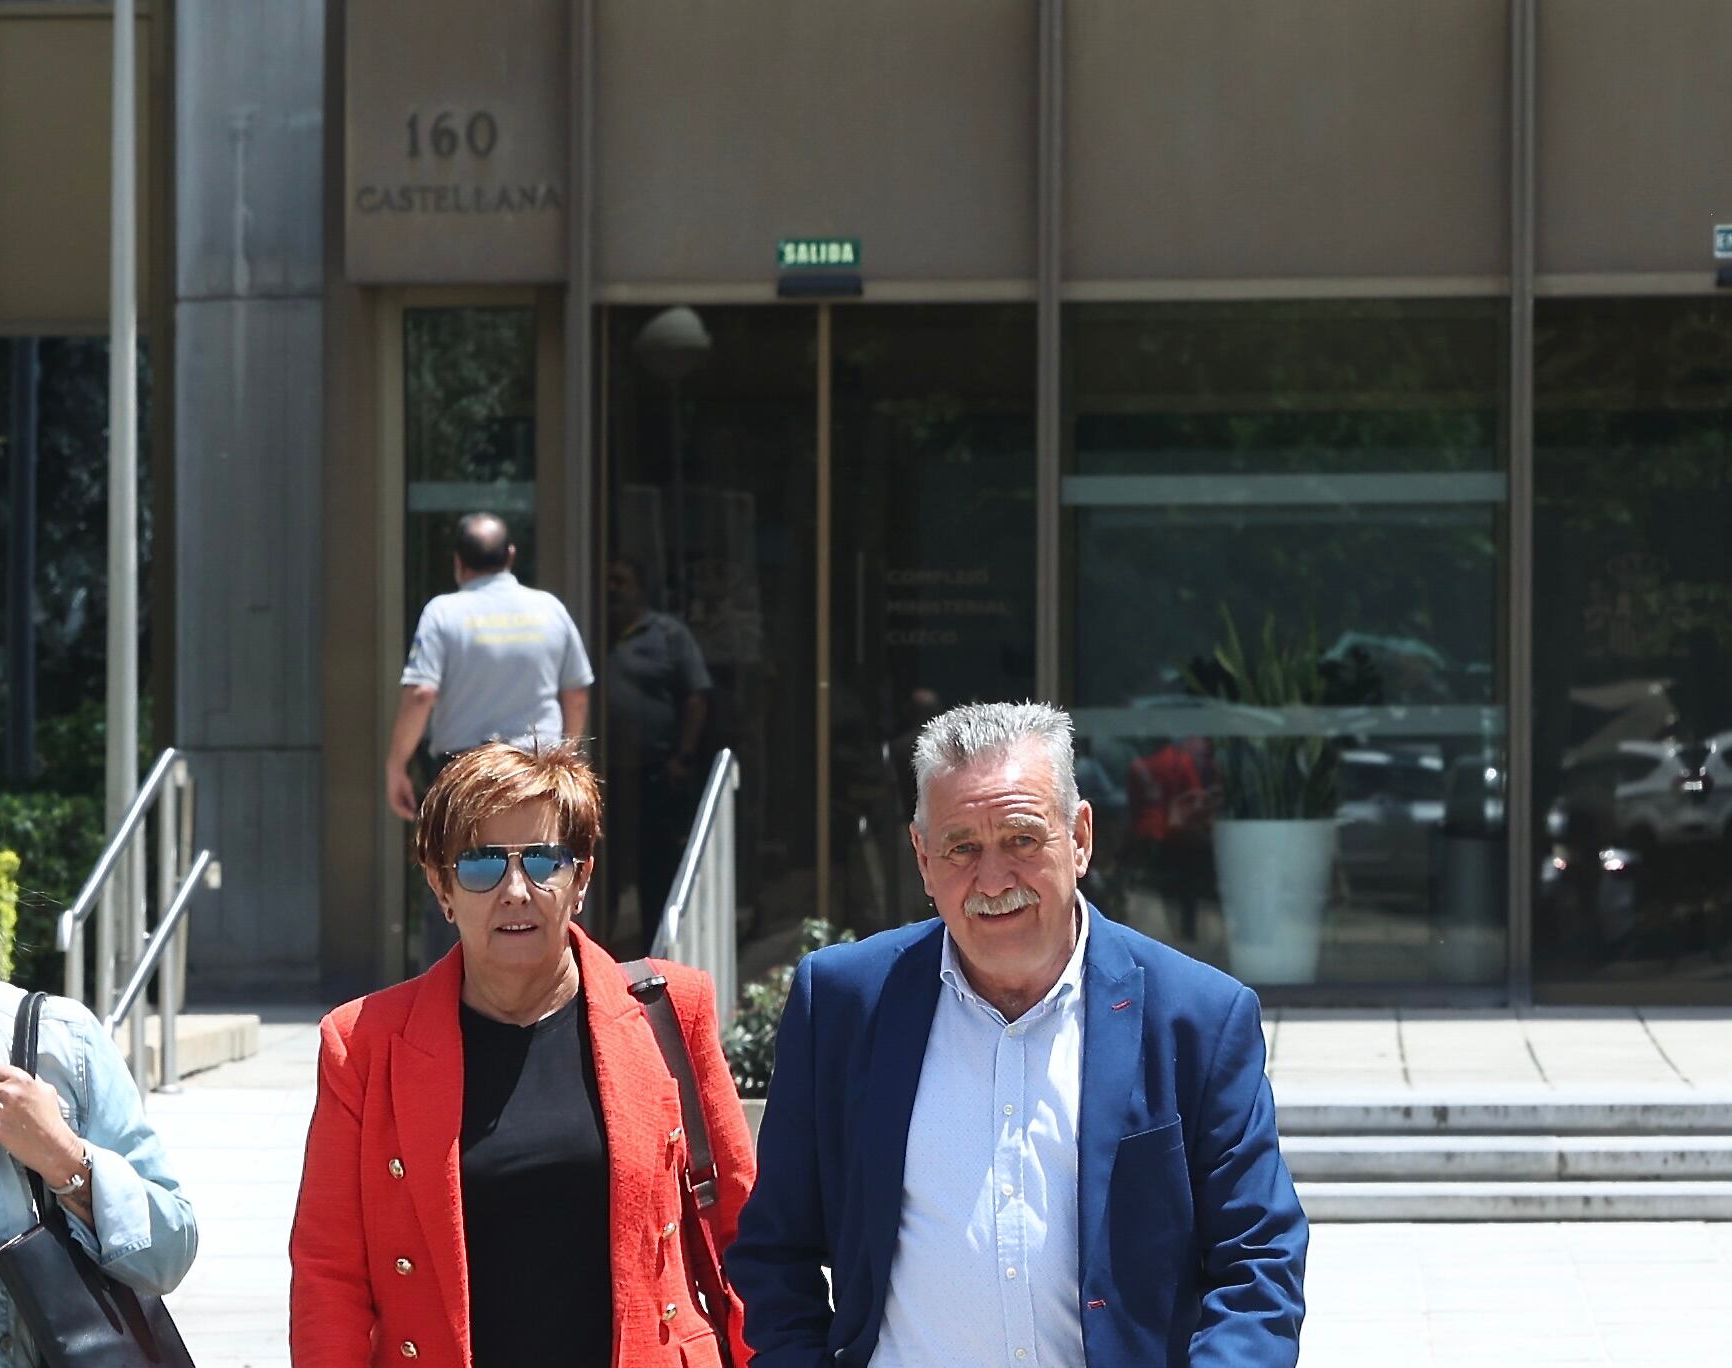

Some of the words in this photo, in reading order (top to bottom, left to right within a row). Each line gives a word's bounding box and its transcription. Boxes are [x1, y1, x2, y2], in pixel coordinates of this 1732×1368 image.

[406, 111, 498, 160] 160
[356, 186, 563, 214] CASTELLANA
[785, 242, 855, 264] SALIDA
[886, 599, 1009, 616] MINISTERIAL
